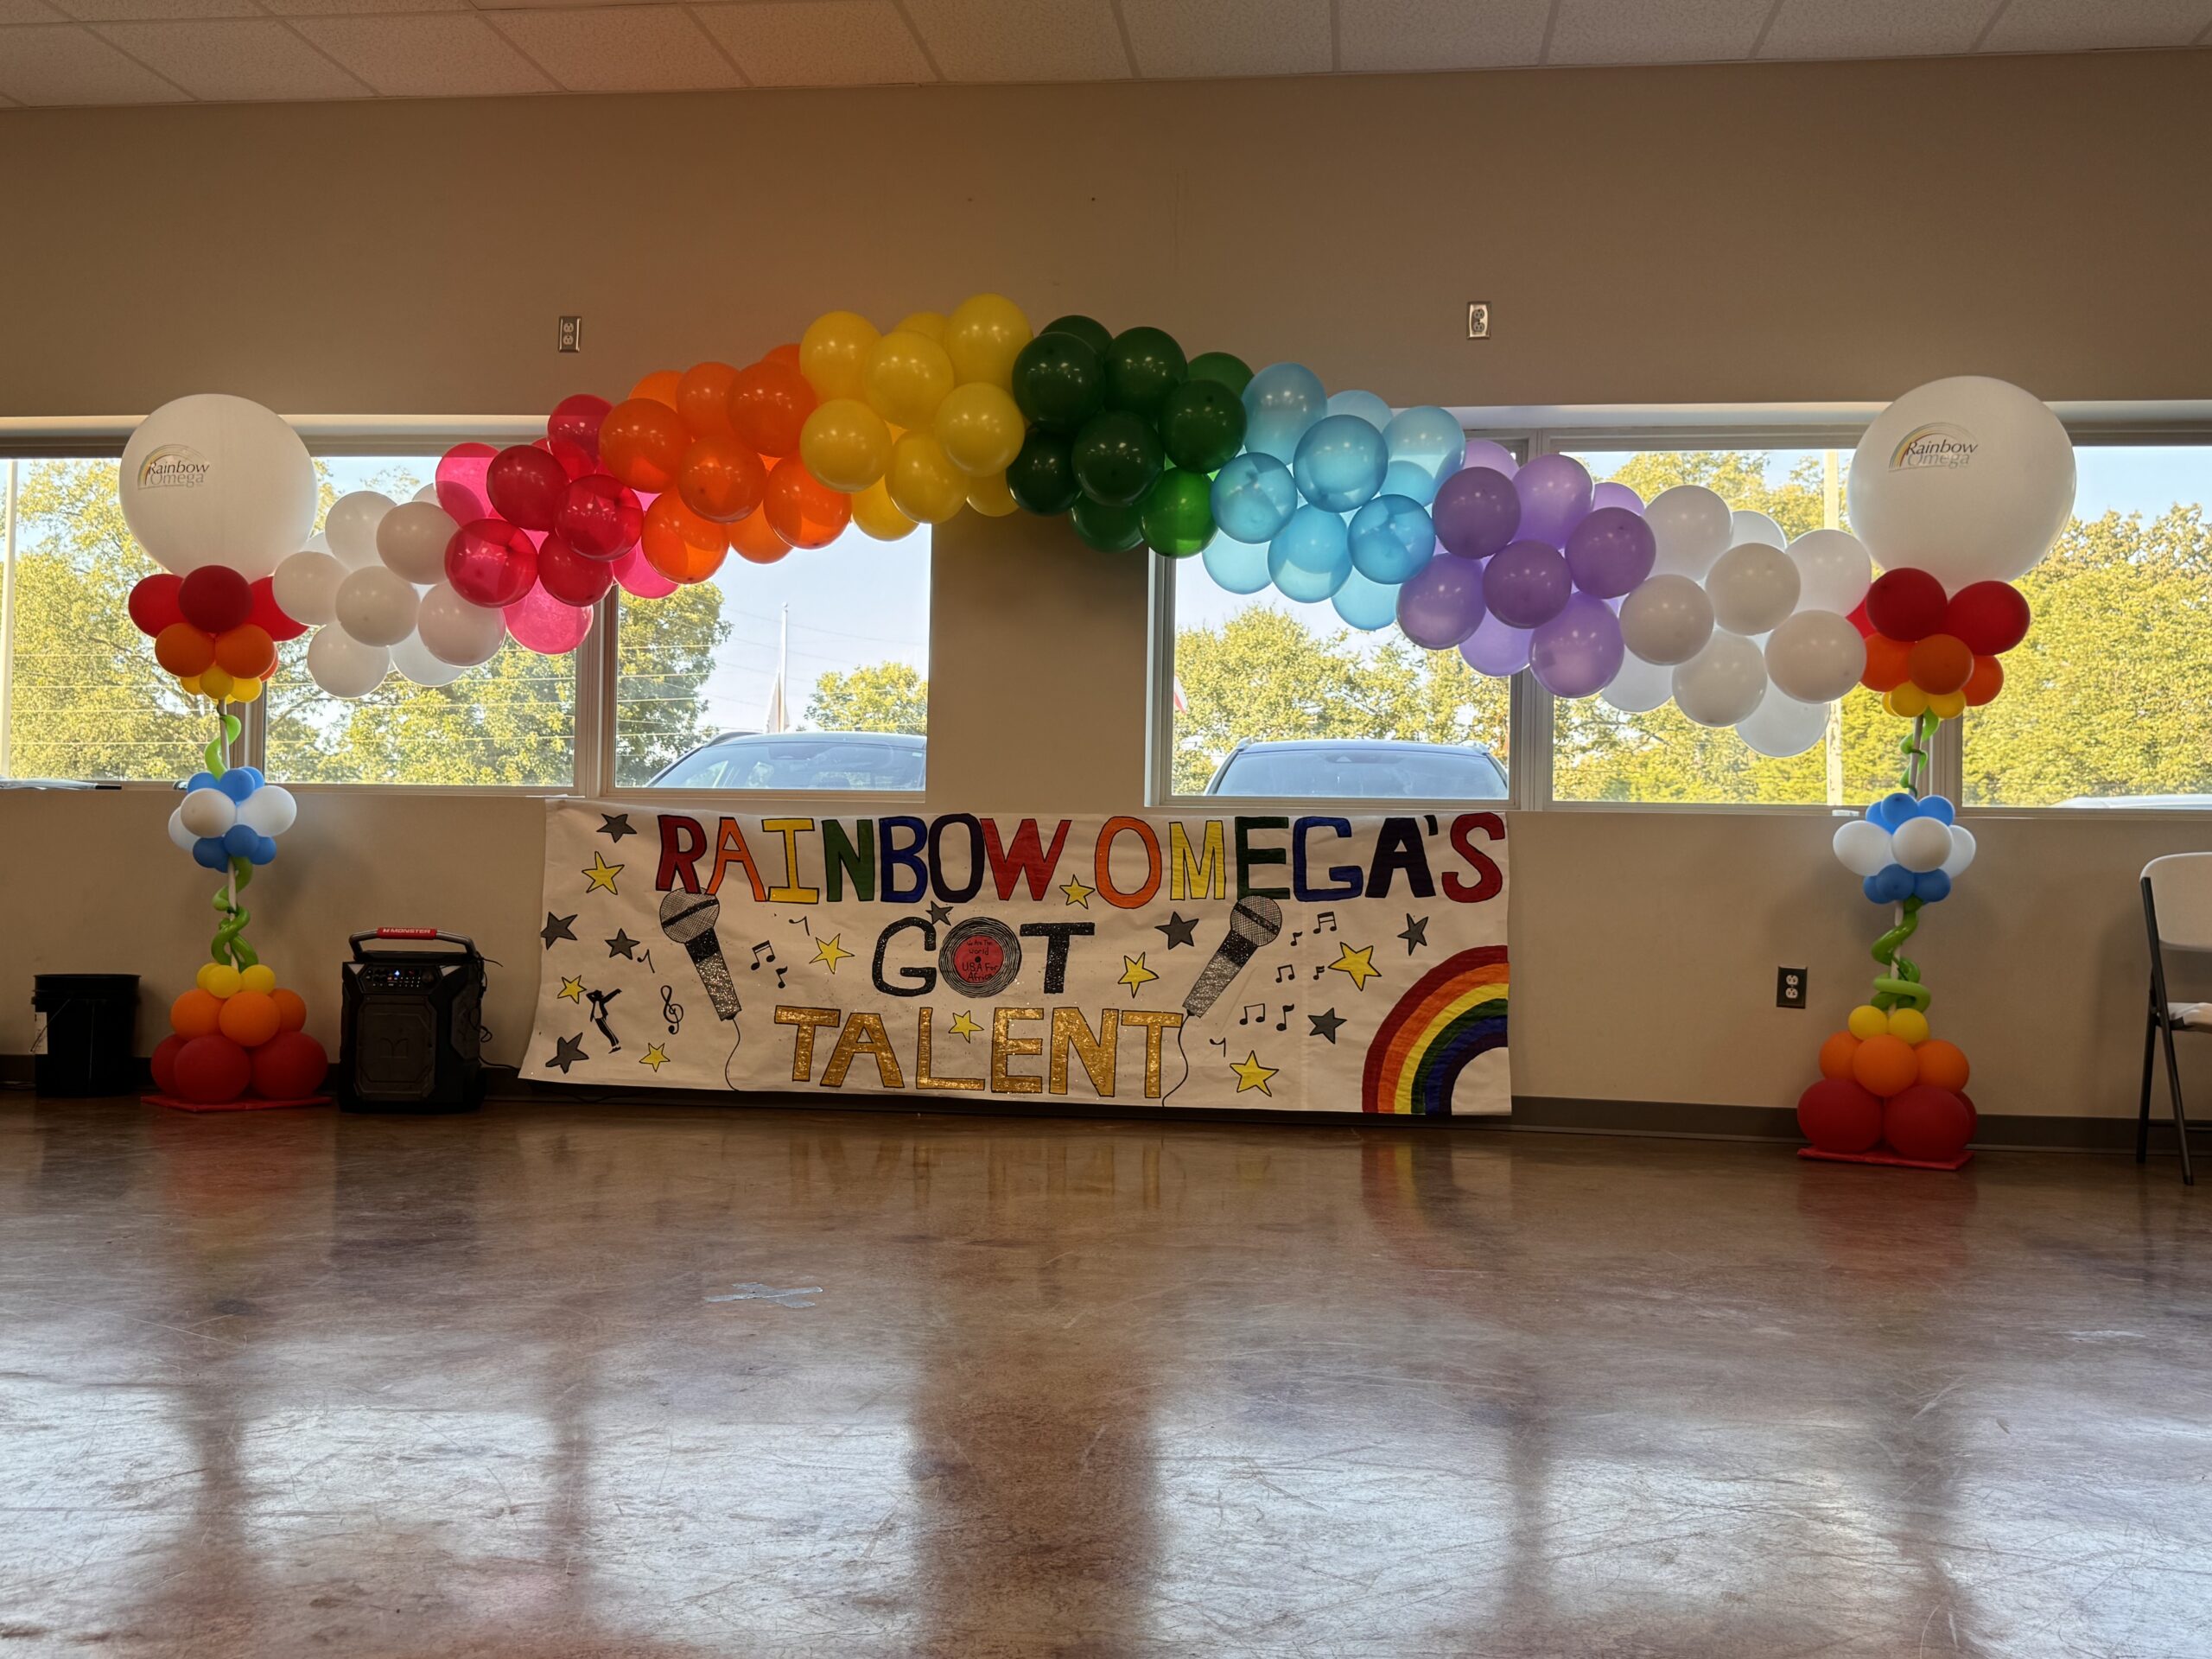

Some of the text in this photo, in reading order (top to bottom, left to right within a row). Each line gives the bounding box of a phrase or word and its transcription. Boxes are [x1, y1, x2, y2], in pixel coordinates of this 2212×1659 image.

[1906, 439, 1979, 455] Rainbow
[149, 461, 211, 475] Rainbow
[1907, 453, 1970, 469] Omega
[149, 473, 205, 488] Omega
[655, 811, 1506, 909] RAINBOW OMEGA'S
[872, 916, 1096, 998] GOT
[962, 962, 983, 973] USA
[774, 1006, 1185, 1099] TALENT
